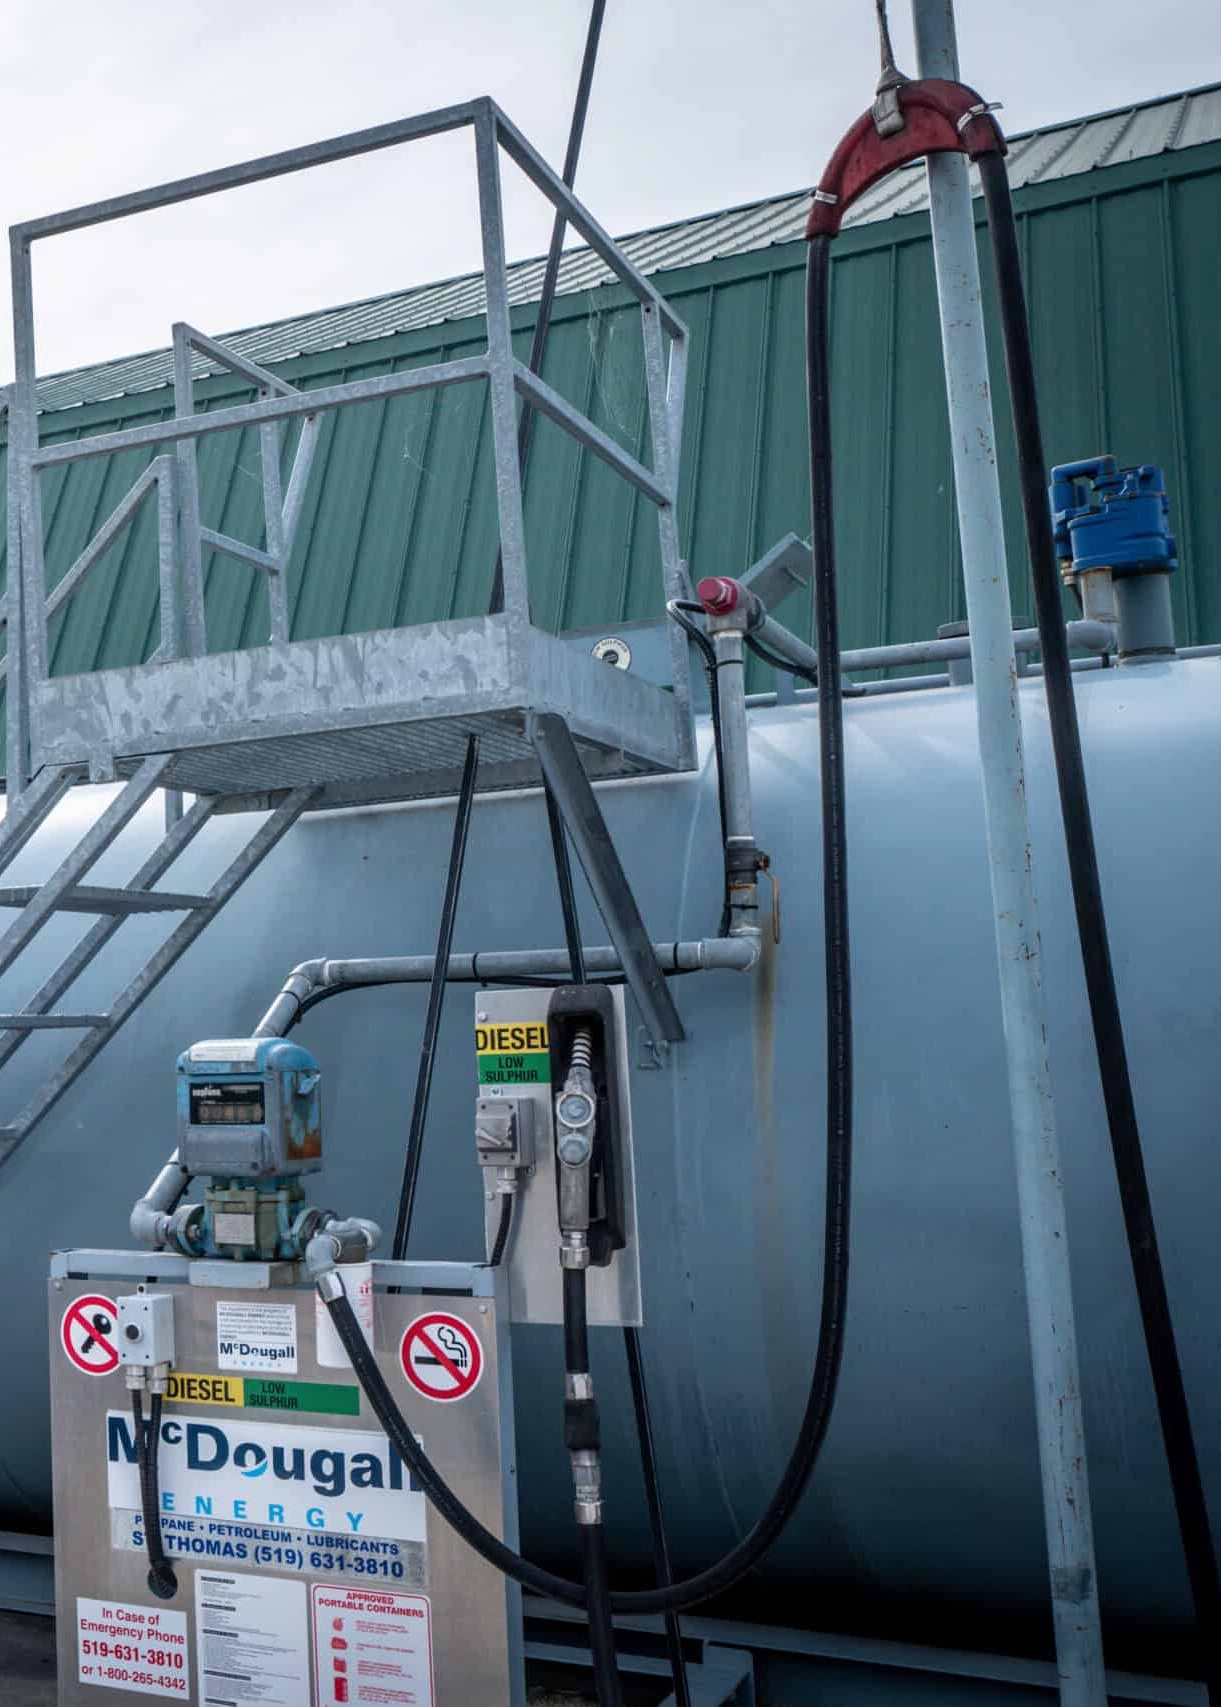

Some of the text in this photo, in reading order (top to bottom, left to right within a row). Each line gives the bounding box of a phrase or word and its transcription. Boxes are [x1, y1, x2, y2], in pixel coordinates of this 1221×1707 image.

[476, 1027, 549, 1050] DIESEL
[498, 1056, 524, 1069] LOW
[485, 1070, 538, 1081] SULPHUR
[220, 1342, 295, 1360] McDougall
[167, 1377, 235, 1402] DIESEL
[262, 1382, 286, 1394] LOW
[249, 1394, 298, 1409] SULPHUR
[108, 1417, 423, 1497] McDougal
[161, 1491, 365, 1532] ENERGY
[135, 1515, 400, 1556] PPANE PETROLEUM LUBRICANTS
[164, 1534, 248, 1559] THOMAS
[254, 1545, 304, 1570] (519)
[310, 1551, 404, 1578] 631-3810
[318, 1598, 425, 1618] PORTABLE CONTAINERS
[346, 1593, 394, 1605] APPROVED
[102, 1608, 160, 1625] In Case of
[80, 1619, 144, 1640] Emergency
[147, 1629, 185, 1644] Phone
[82, 1639, 183, 1669] 519-631-3810
[81, 1665, 94, 1675] or
[97, 1666, 186, 1690] 1-800-265-4342
